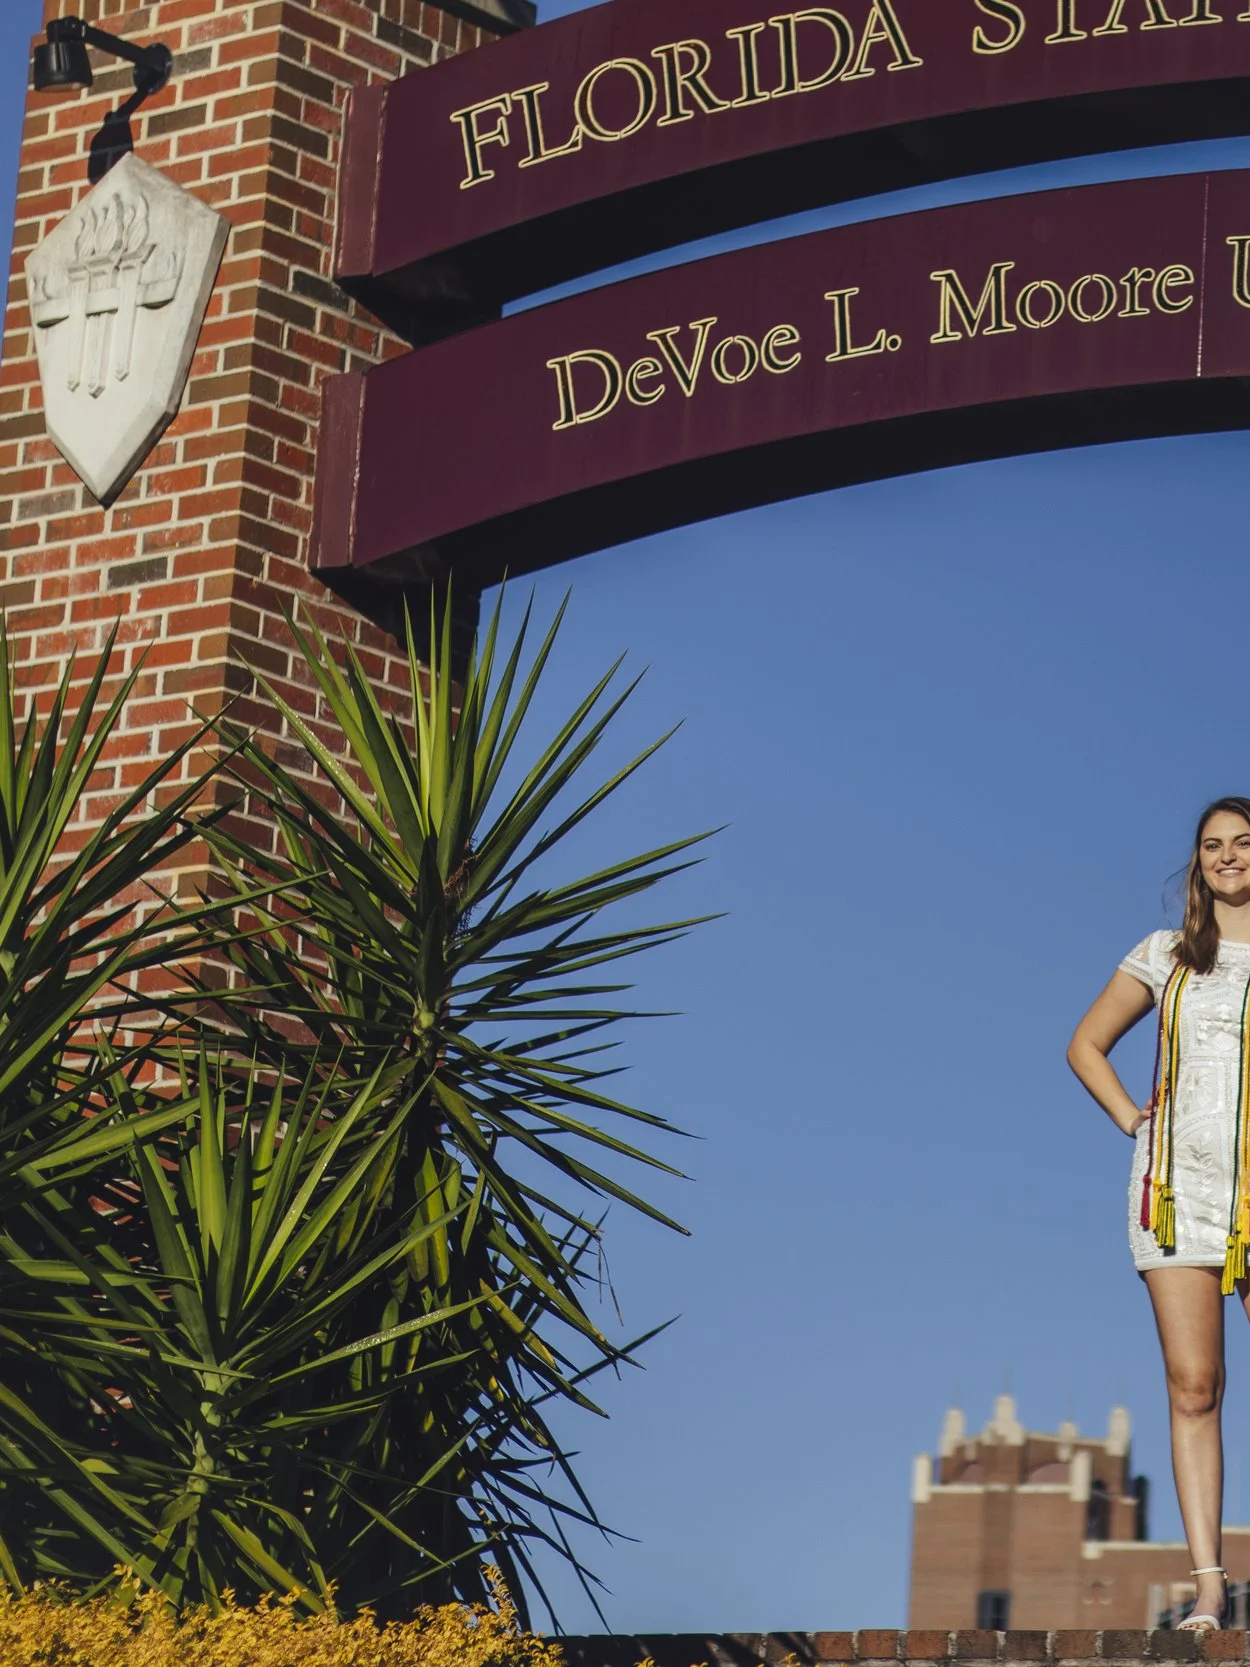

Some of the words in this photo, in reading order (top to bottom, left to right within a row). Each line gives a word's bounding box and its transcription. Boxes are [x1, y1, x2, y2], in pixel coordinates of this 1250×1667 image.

[450, 0, 923, 189] FLORIDA
[546, 317, 801, 430] DeVoe
[824, 287, 902, 363] L.
[930, 262, 1194, 343] Moore
